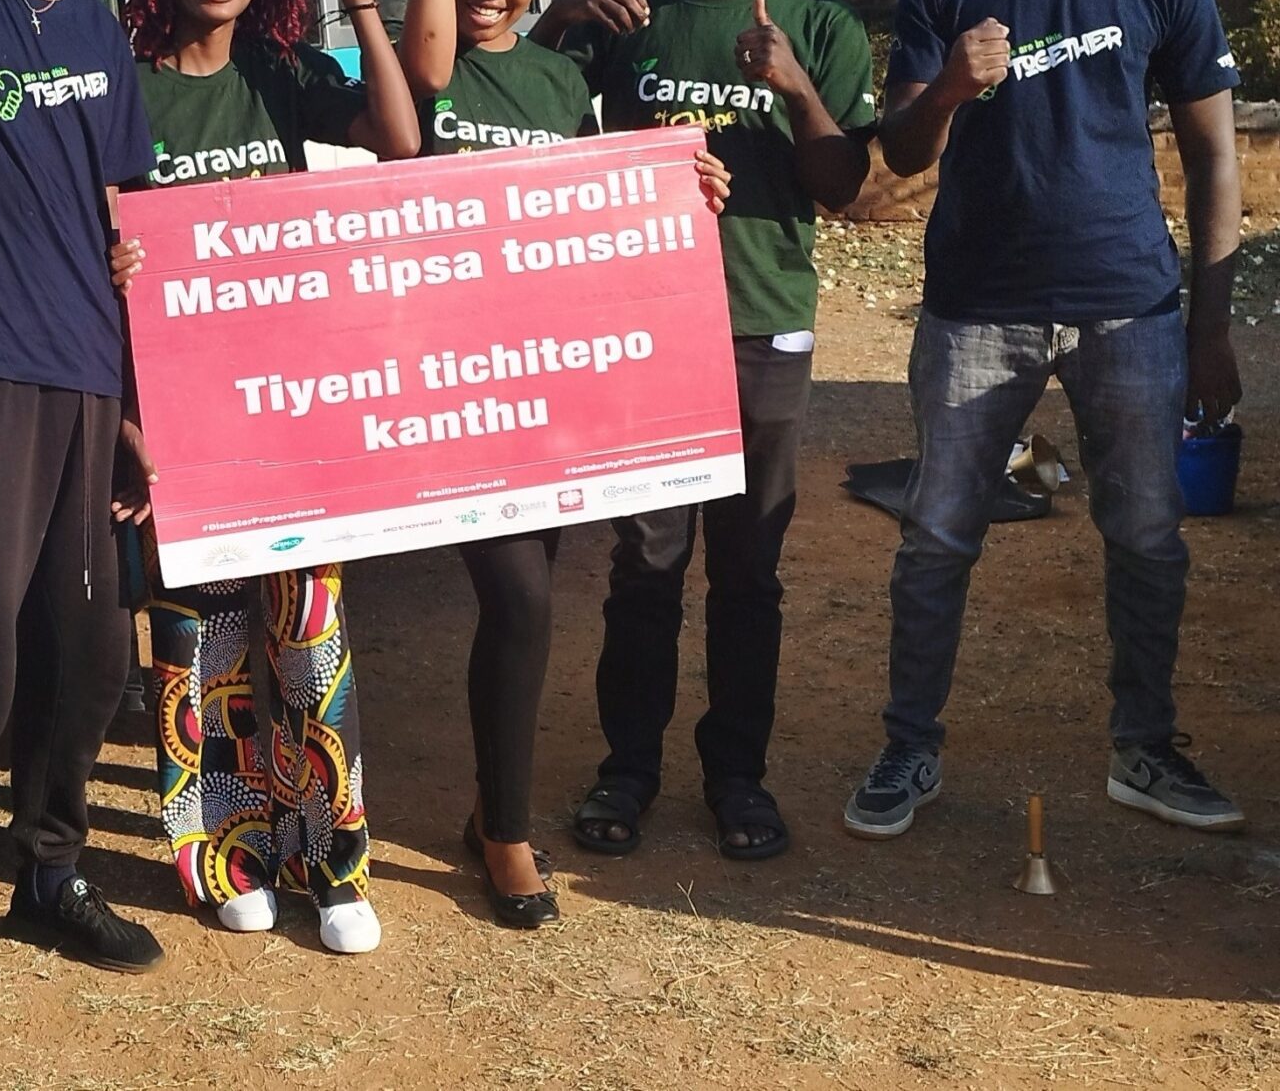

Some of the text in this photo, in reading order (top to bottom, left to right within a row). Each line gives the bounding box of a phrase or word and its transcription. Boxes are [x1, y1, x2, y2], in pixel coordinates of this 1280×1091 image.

[1008, 25, 1123, 81] TOGETHER
[1019, 43, 1034, 54] are
[1034, 39, 1044, 48] in
[1045, 32, 1063, 44] this
[638, 72, 774, 113] Caravan
[433, 111, 565, 147] Caravan
[669, 108, 738, 134] Hope
[153, 138, 287, 185] Caravan
[194, 166, 658, 260] Kwatentha lero!!!
[163, 212, 695, 317] Mawa tipsa tonse!!!
[235, 330, 653, 417] Tiyeni tichitepo
[363, 398, 549, 451] kanthu
[202, 507, 326, 532] #DisasterPreparedness
